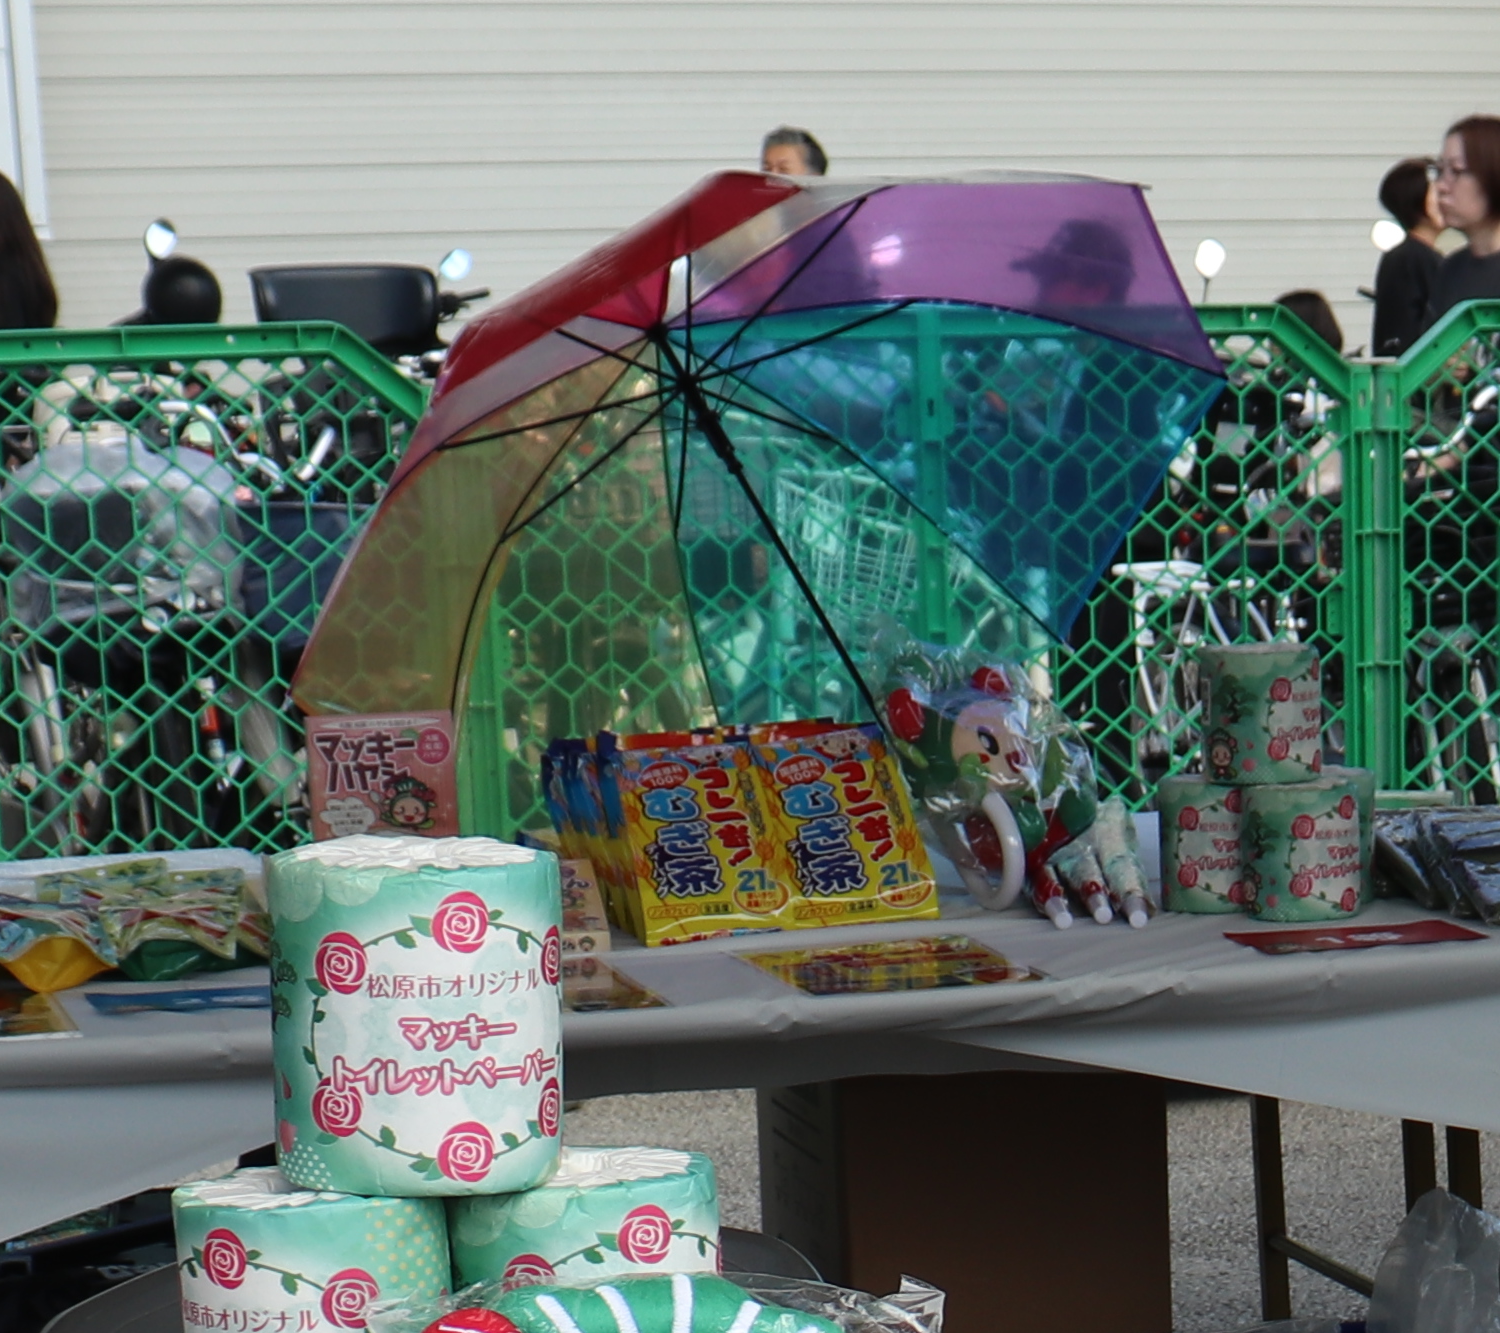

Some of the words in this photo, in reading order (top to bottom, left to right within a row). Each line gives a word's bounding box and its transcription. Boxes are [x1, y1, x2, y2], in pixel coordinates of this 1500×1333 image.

[314, 731, 417, 763] マッキー
[642, 785, 725, 897] むぎ茶
[780, 781, 869, 896] むぎ茶
[366, 969, 541, 1000] 松原市オリジナル
[399, 1014, 517, 1051] マッキー
[331, 1056, 557, 1097] トイレットペーパー
